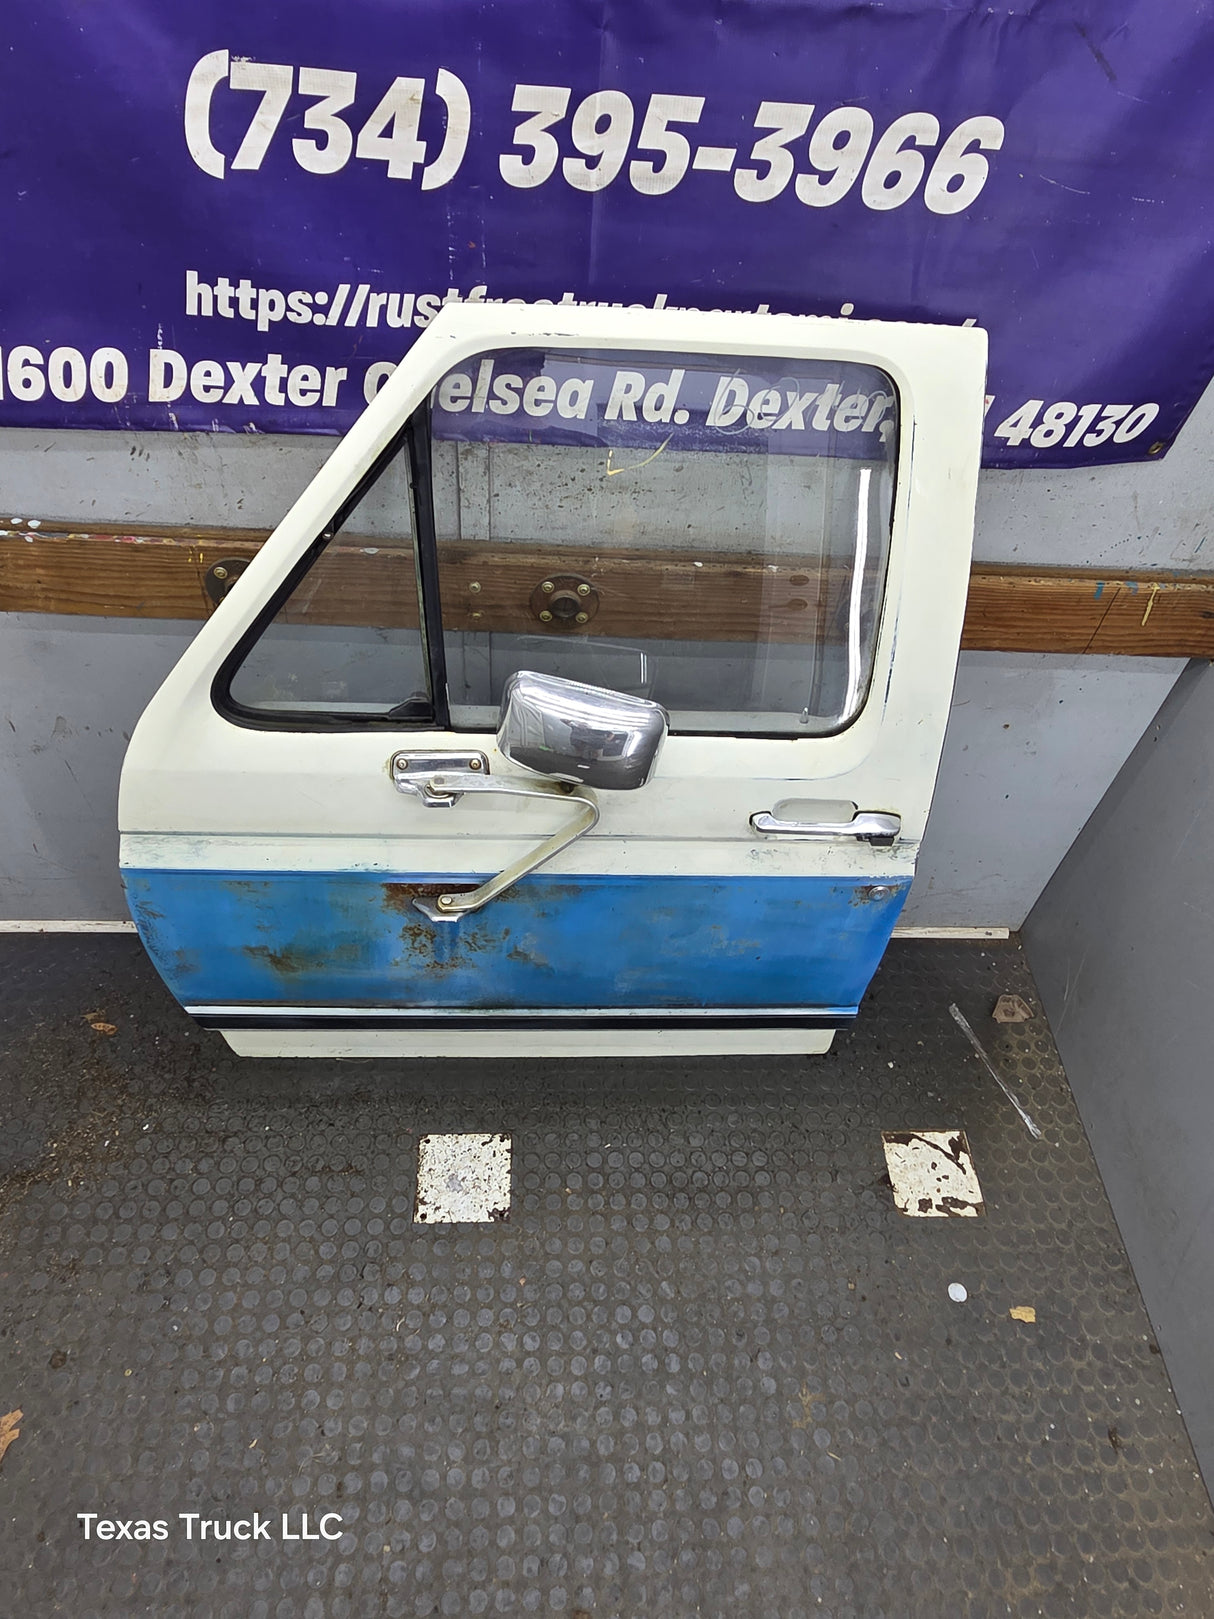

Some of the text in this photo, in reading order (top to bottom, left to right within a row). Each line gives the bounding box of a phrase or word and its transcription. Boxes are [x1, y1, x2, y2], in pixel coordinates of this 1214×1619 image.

[184, 49, 1005, 215] (734) 395-3966
[0, 345, 129, 403] 600
[148, 348, 348, 408] Dexter
[363, 358, 595, 418] Celsea
[604, 368, 689, 426] Rd.
[705, 375, 895, 443] Dexter,
[993, 399, 1160, 449] 48130
